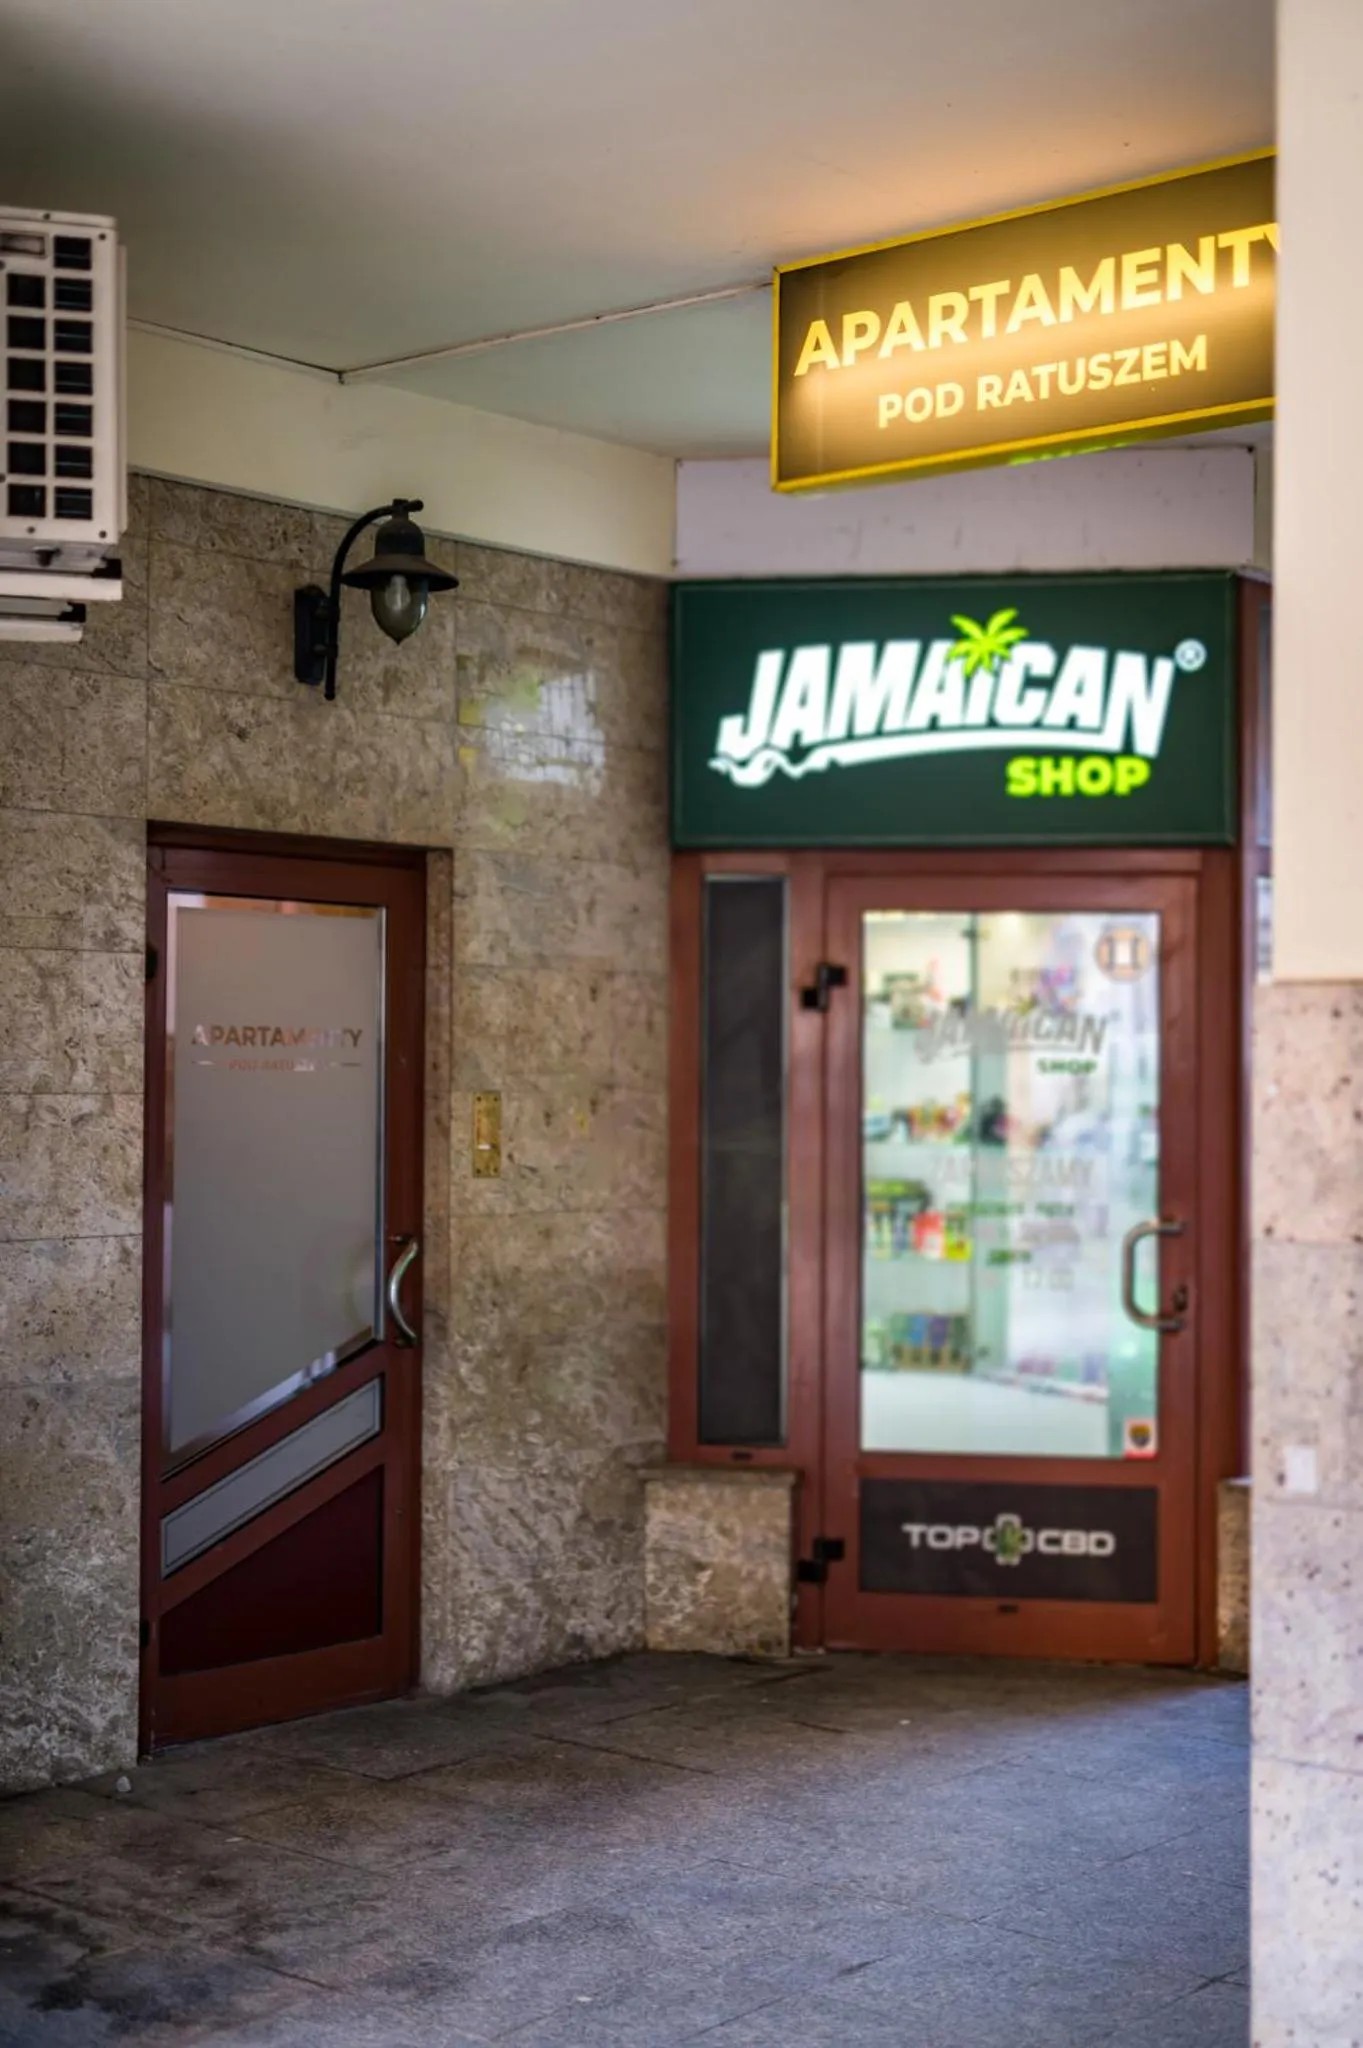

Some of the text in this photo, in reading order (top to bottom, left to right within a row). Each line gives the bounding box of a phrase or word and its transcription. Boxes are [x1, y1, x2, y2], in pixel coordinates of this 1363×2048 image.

[876, 335, 1207, 430] POD RATUSZEM
[714, 637, 1175, 760] JAMAICAN
[1004, 756, 1151, 797] SHOP
[1036, 1058, 1097, 1074] SHOP
[902, 1523, 1116, 1556] TOP CBD
